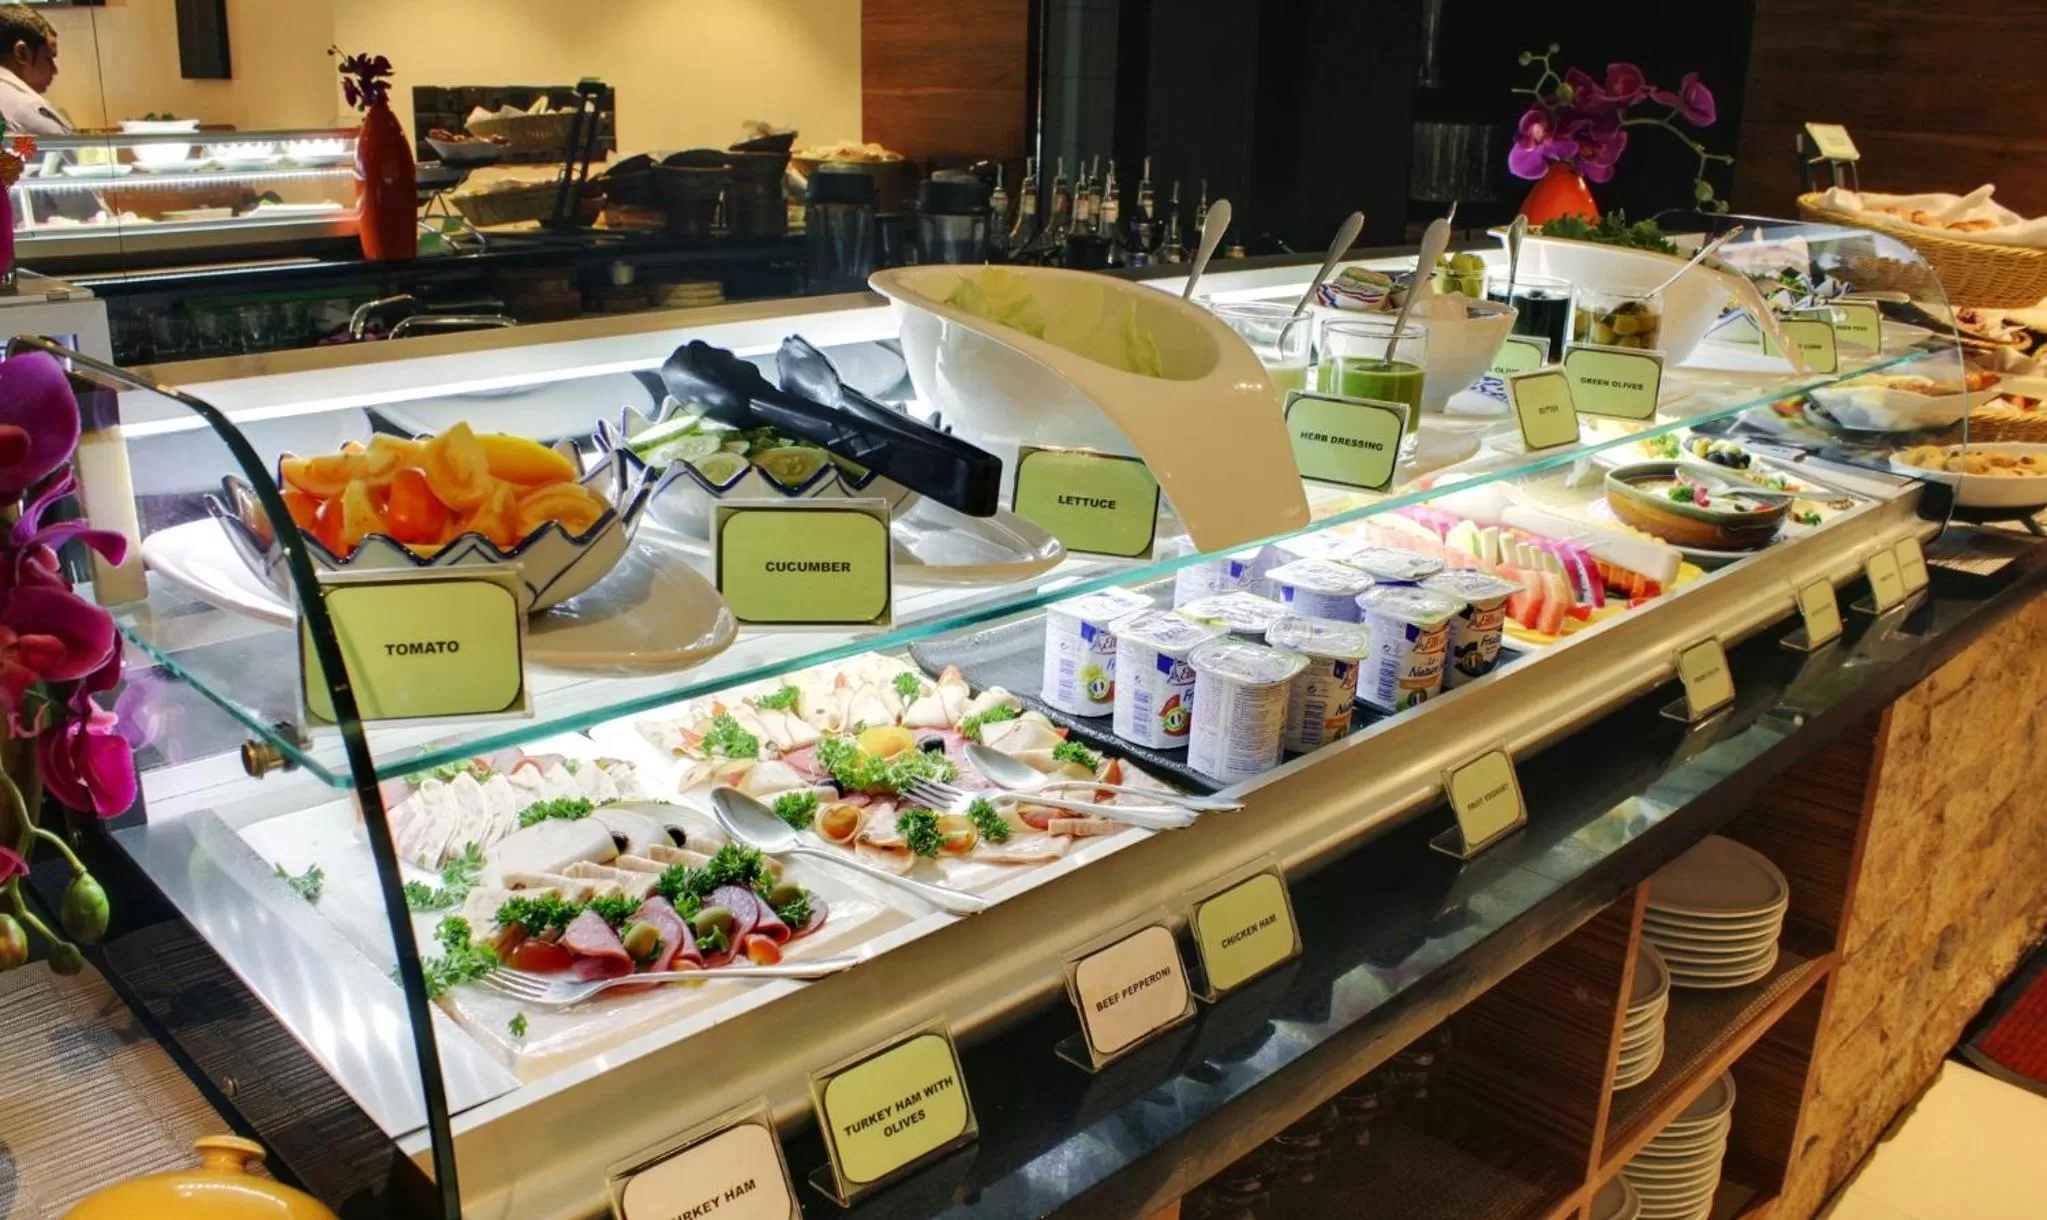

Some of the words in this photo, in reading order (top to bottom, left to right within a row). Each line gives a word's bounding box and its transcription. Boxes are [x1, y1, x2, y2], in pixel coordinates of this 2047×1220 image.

[1580, 377, 1610, 386] GREEN
[1611, 381, 1644, 391] OLIVES
[1300, 431, 1328, 442] HERB
[1330, 436, 1384, 451] DRESSING
[1058, 495, 1117, 510] LETTUCE
[765, 561, 851, 573] CUCUMBER
[384, 640, 460, 656] TOMATO
[1221, 925, 1258, 949] CHICKEN
[1259, 913, 1277, 932] HAM
[1096, 993, 1120, 1012] BEEF
[1122, 966, 1171, 998] PEPPERONI
[844, 1105, 892, 1137] TURKEY
[895, 1091, 922, 1113] HAM
[924, 1075, 953, 1098] WITH
[883, 1109, 926, 1137] OLIVES
[724, 1178, 756, 1203] HAM
